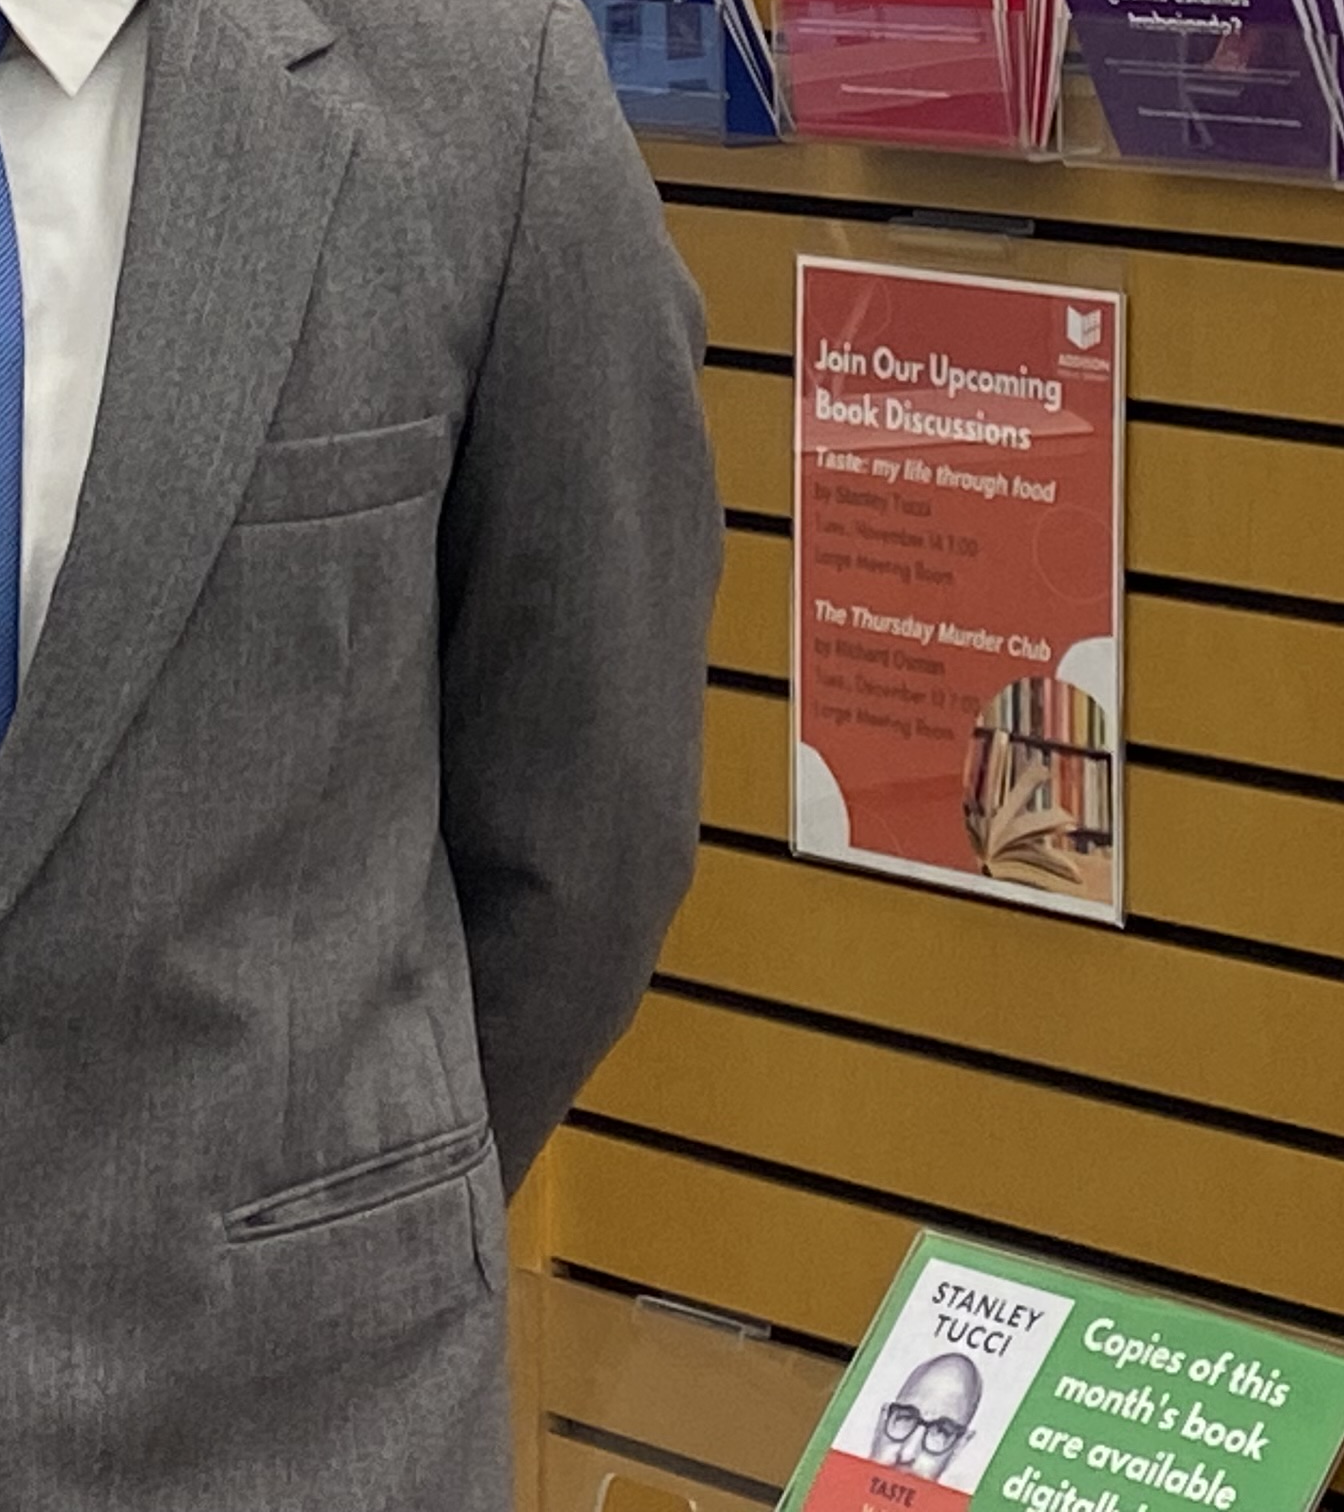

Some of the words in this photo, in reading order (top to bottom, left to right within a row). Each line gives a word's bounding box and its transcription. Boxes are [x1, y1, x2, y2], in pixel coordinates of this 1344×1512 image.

[815, 338, 866, 376] Join
[873, 345, 924, 382] Our
[929, 353, 1063, 413] Upcoming
[815, 388, 879, 429] Book
[885, 397, 1033, 450] Discussions
[815, 445, 866, 474] Taste:
[872, 457, 901, 485] my
[935, 465, 1008, 500] through
[1011, 475, 1056, 504] food
[815, 599, 847, 625] The
[850, 605, 935, 645] Thursday
[938, 622, 1004, 653] Murder
[1008, 634, 1052, 663] Club
[931, 1280, 1046, 1334] STANLEY
[933, 1312, 1014, 1359] TUCCI
[1082, 1316, 1187, 1377] Copies
[1187, 1350, 1228, 1387] of
[1228, 1359, 1291, 1409] this
[1054, 1372, 1178, 1432] month's
[1180, 1400, 1271, 1462] book
[870, 1475, 918, 1509] TASTE
[1028, 1422, 1083, 1462] are
[1086, 1439, 1238, 1512] available
